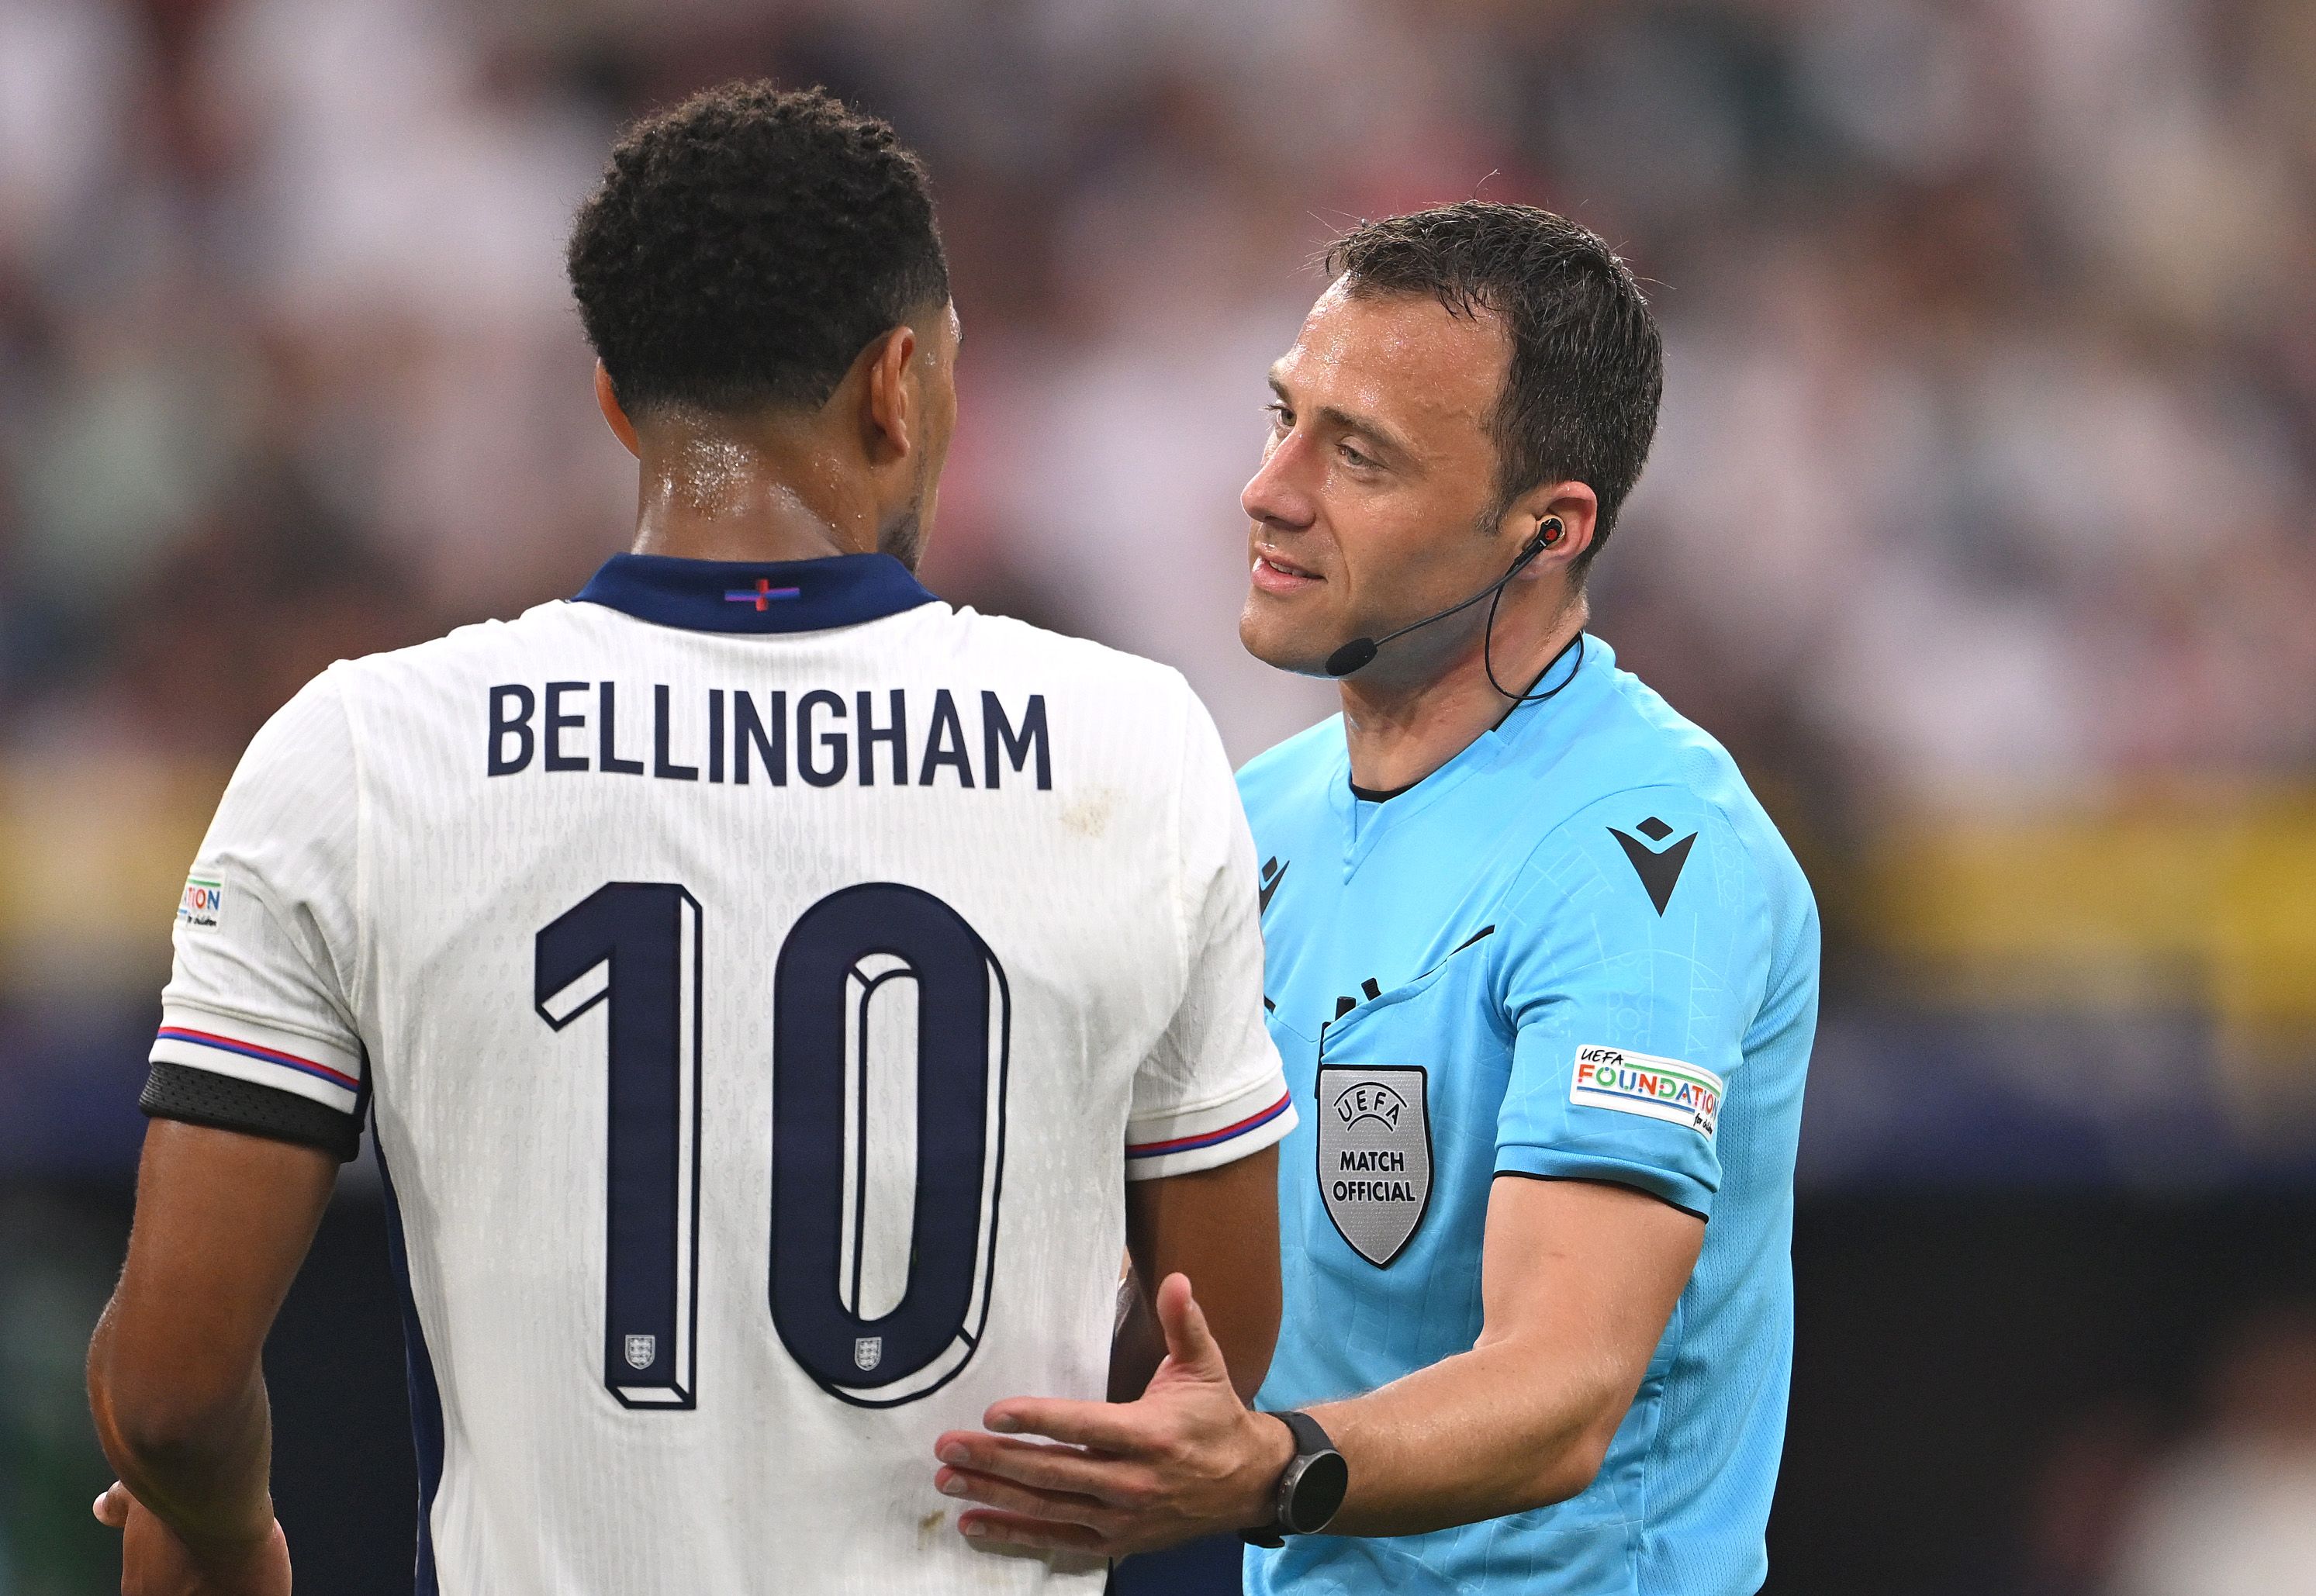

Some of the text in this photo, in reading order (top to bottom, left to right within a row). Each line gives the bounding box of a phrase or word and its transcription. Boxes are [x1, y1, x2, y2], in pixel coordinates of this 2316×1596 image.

[489, 681, 1052, 790] BELLINGHAM
[185, 886, 220, 910] TION
[1581, 1048, 1623, 1065] UEFA
[1578, 1064, 1719, 1118] FOUNDATION
[1337, 1090, 1401, 1125] UEFA
[535, 882, 1010, 1408] 10
[1339, 1151, 1404, 1172] MATCH
[1333, 1180, 1416, 1201] OFFICIAL
